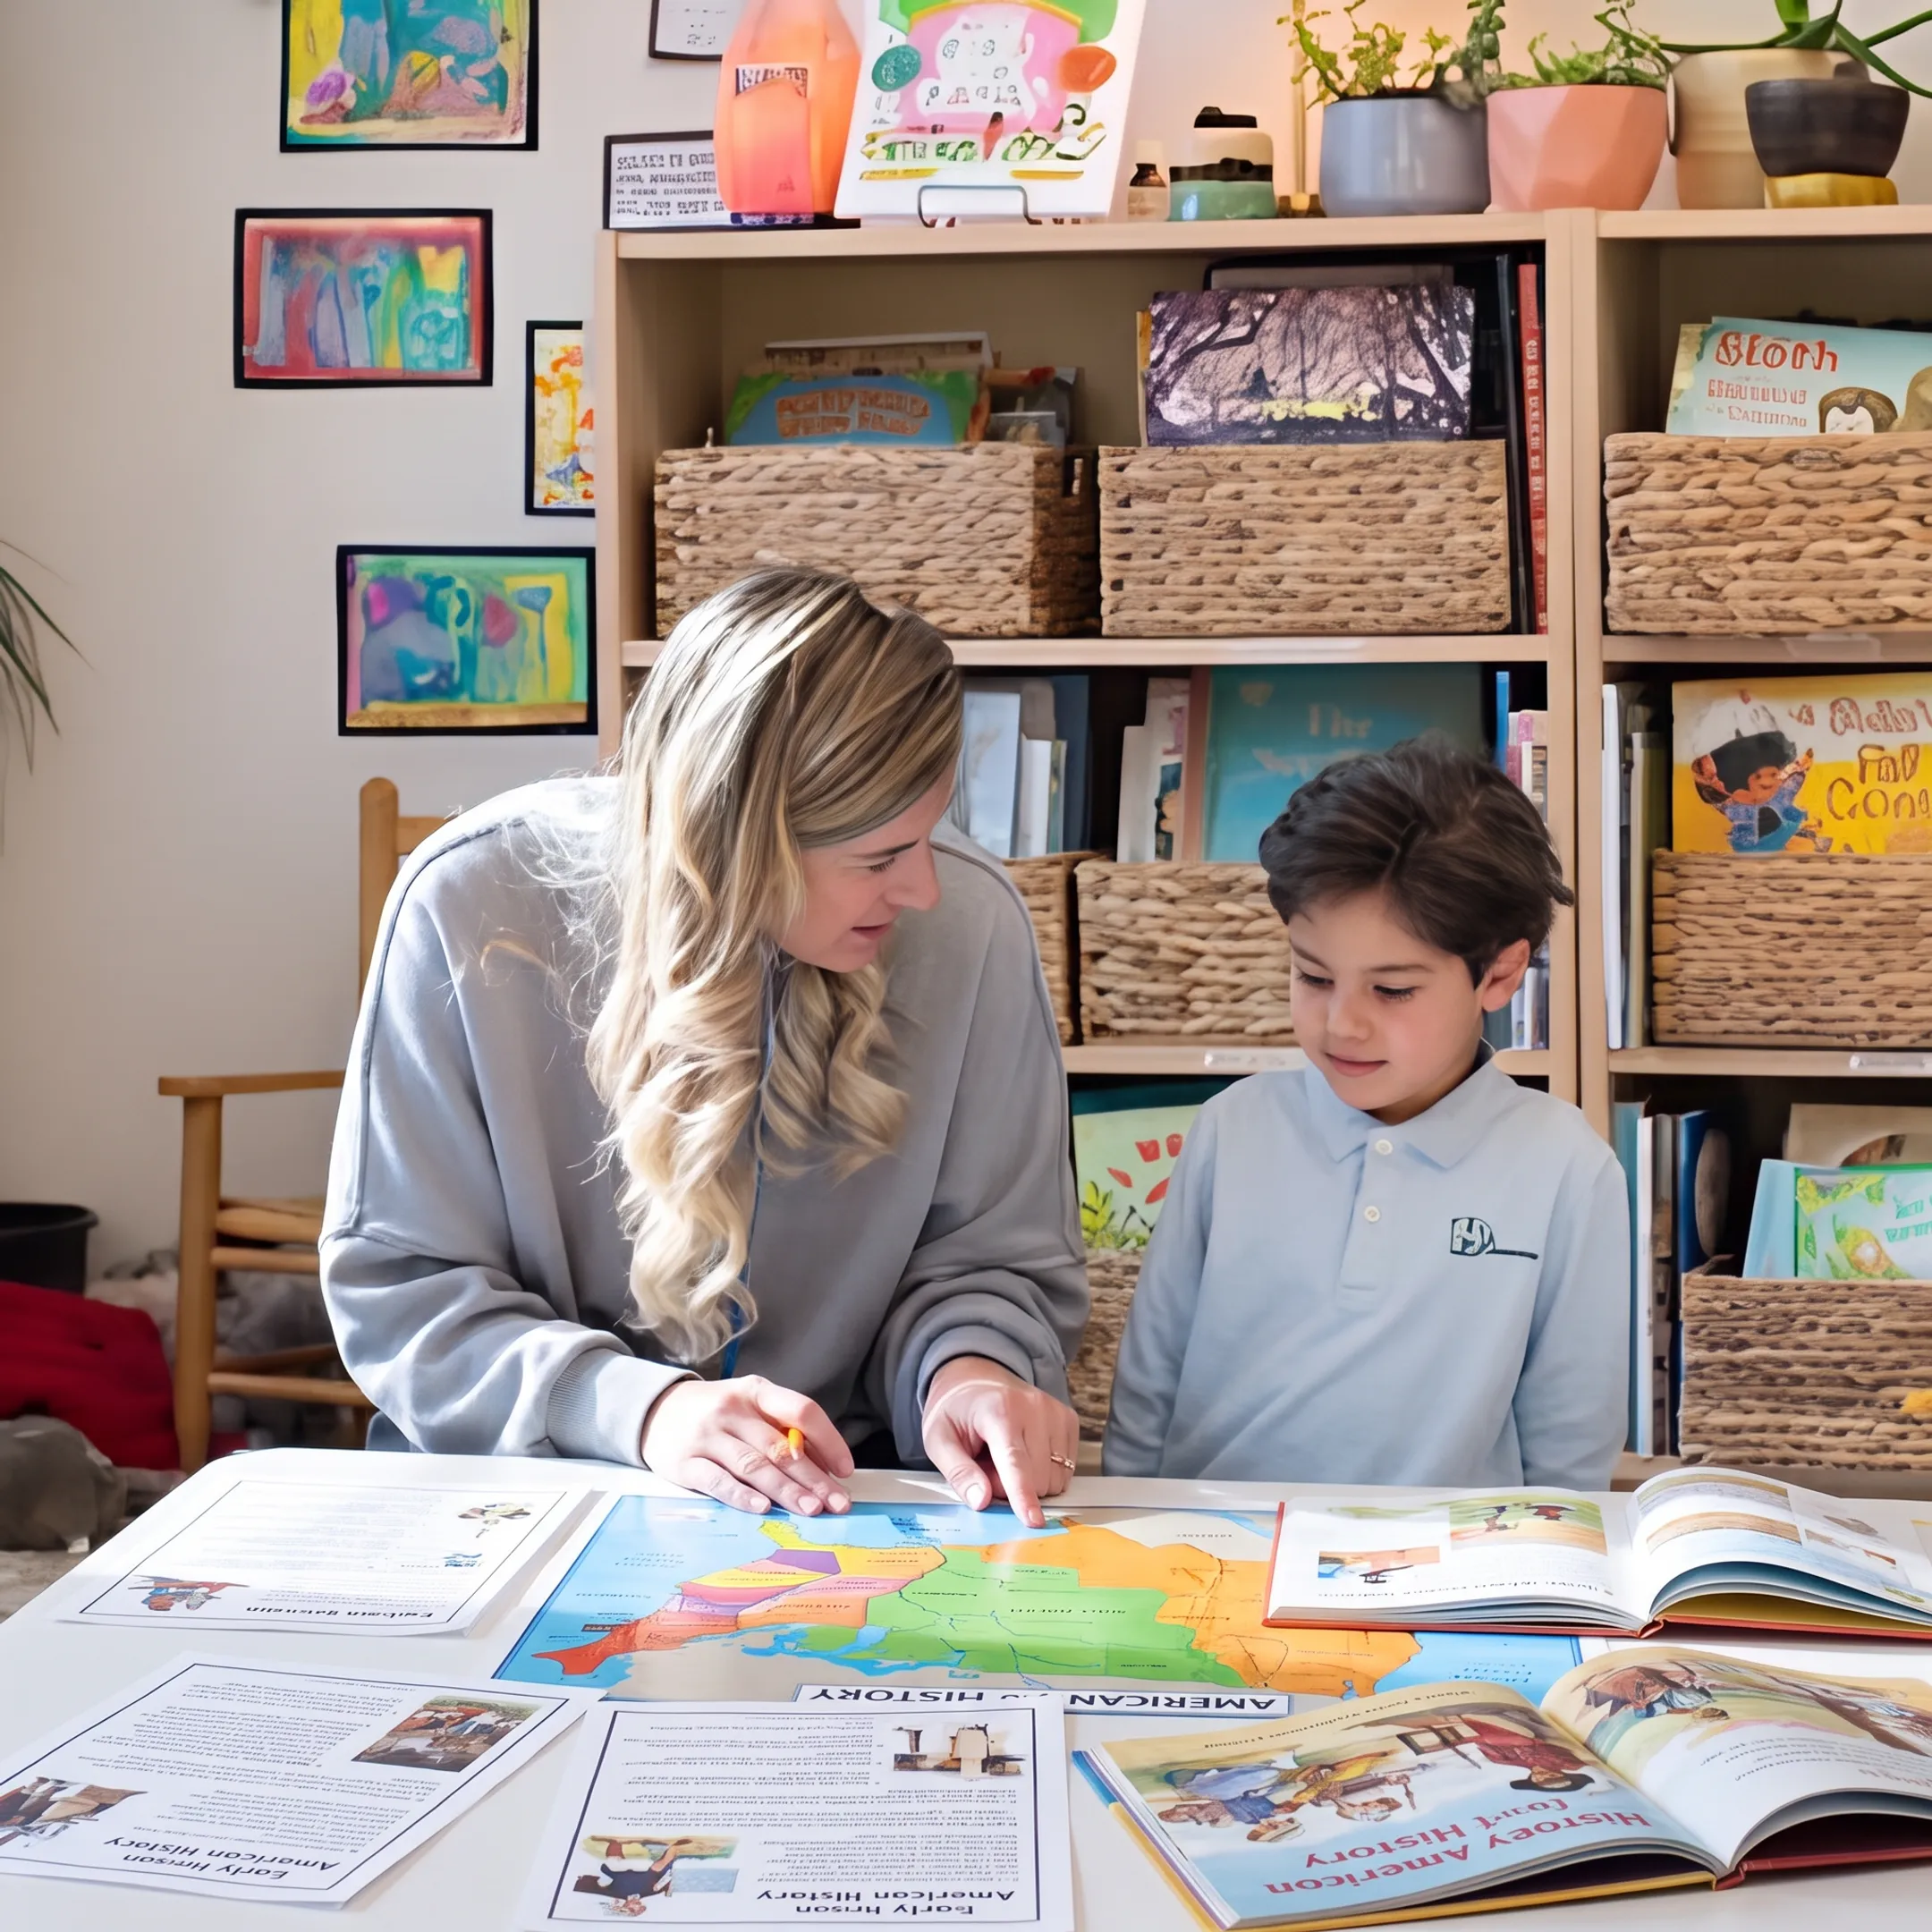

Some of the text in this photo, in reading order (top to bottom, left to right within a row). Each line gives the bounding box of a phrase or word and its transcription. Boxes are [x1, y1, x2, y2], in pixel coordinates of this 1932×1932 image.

[809, 1687, 1277, 1710] AMERICAN HISTORY
[1306, 1824, 1467, 1868] History
